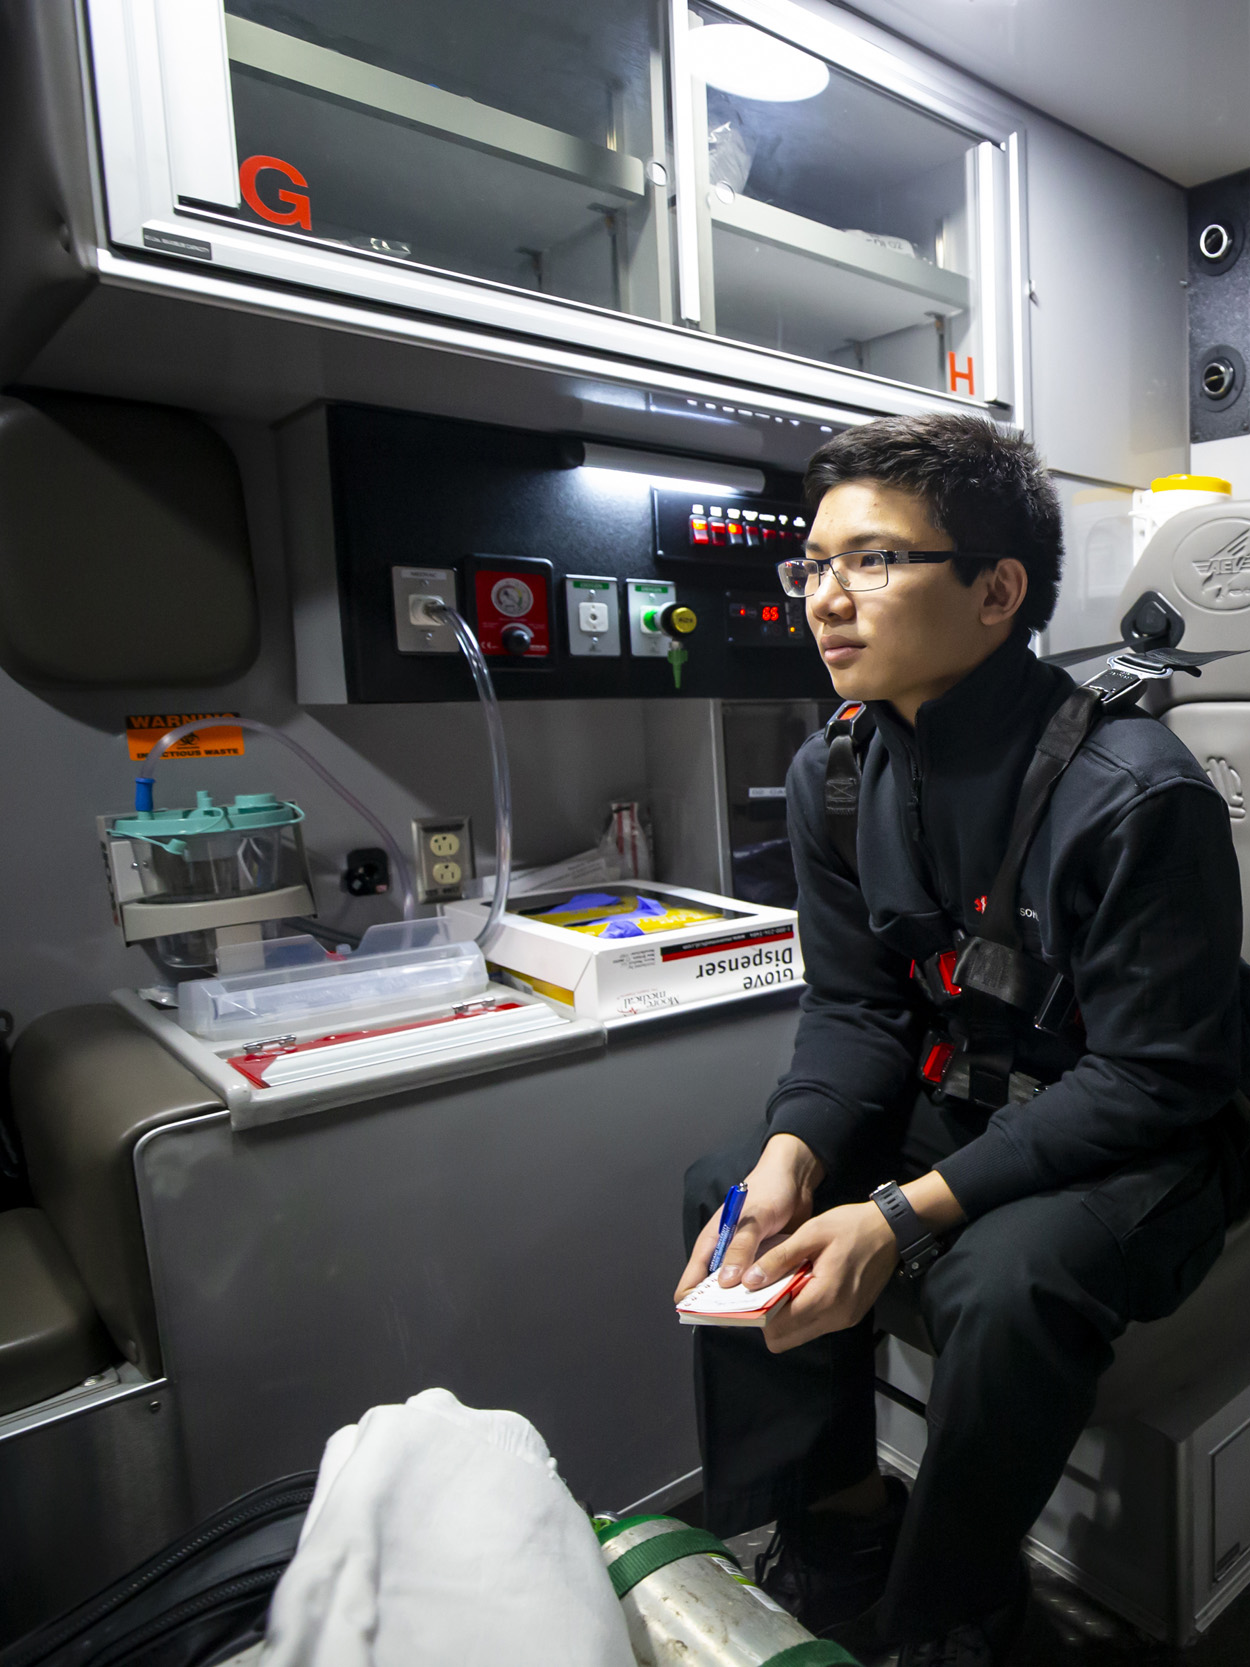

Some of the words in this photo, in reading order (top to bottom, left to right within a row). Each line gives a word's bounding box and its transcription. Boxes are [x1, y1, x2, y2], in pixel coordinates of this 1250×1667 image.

[240, 155, 312, 231] G
[948, 351, 975, 396] H
[204, 748, 239, 756] WASTE
[696, 947, 793, 979] Dispenser
[743, 968, 794, 990] Glove
